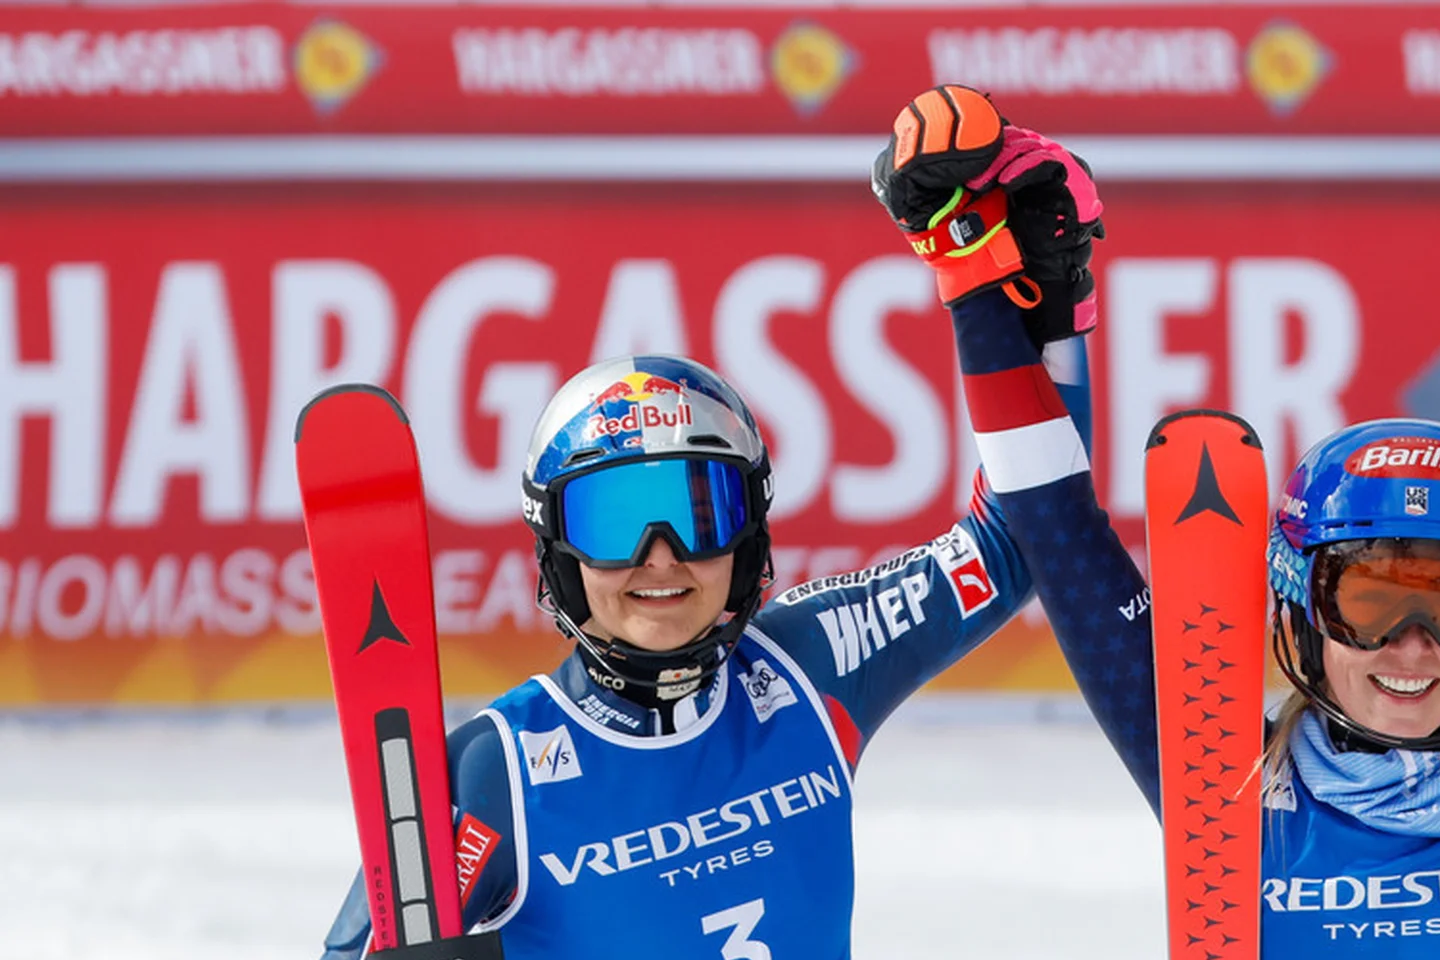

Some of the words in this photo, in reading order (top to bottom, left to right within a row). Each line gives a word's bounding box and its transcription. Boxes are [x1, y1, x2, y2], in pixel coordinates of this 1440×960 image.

[0, 26, 287, 96] ARGASSNER
[452, 29, 766, 95] HARGASSNER
[929, 29, 1241, 96] HARGASSNER
[589, 406, 638, 438] Red
[643, 404, 692, 428] Bull
[0, 547, 326, 641] IOMASS
[538, 765, 841, 887] VREDESTEIN
[659, 839, 775, 888] TYRES
